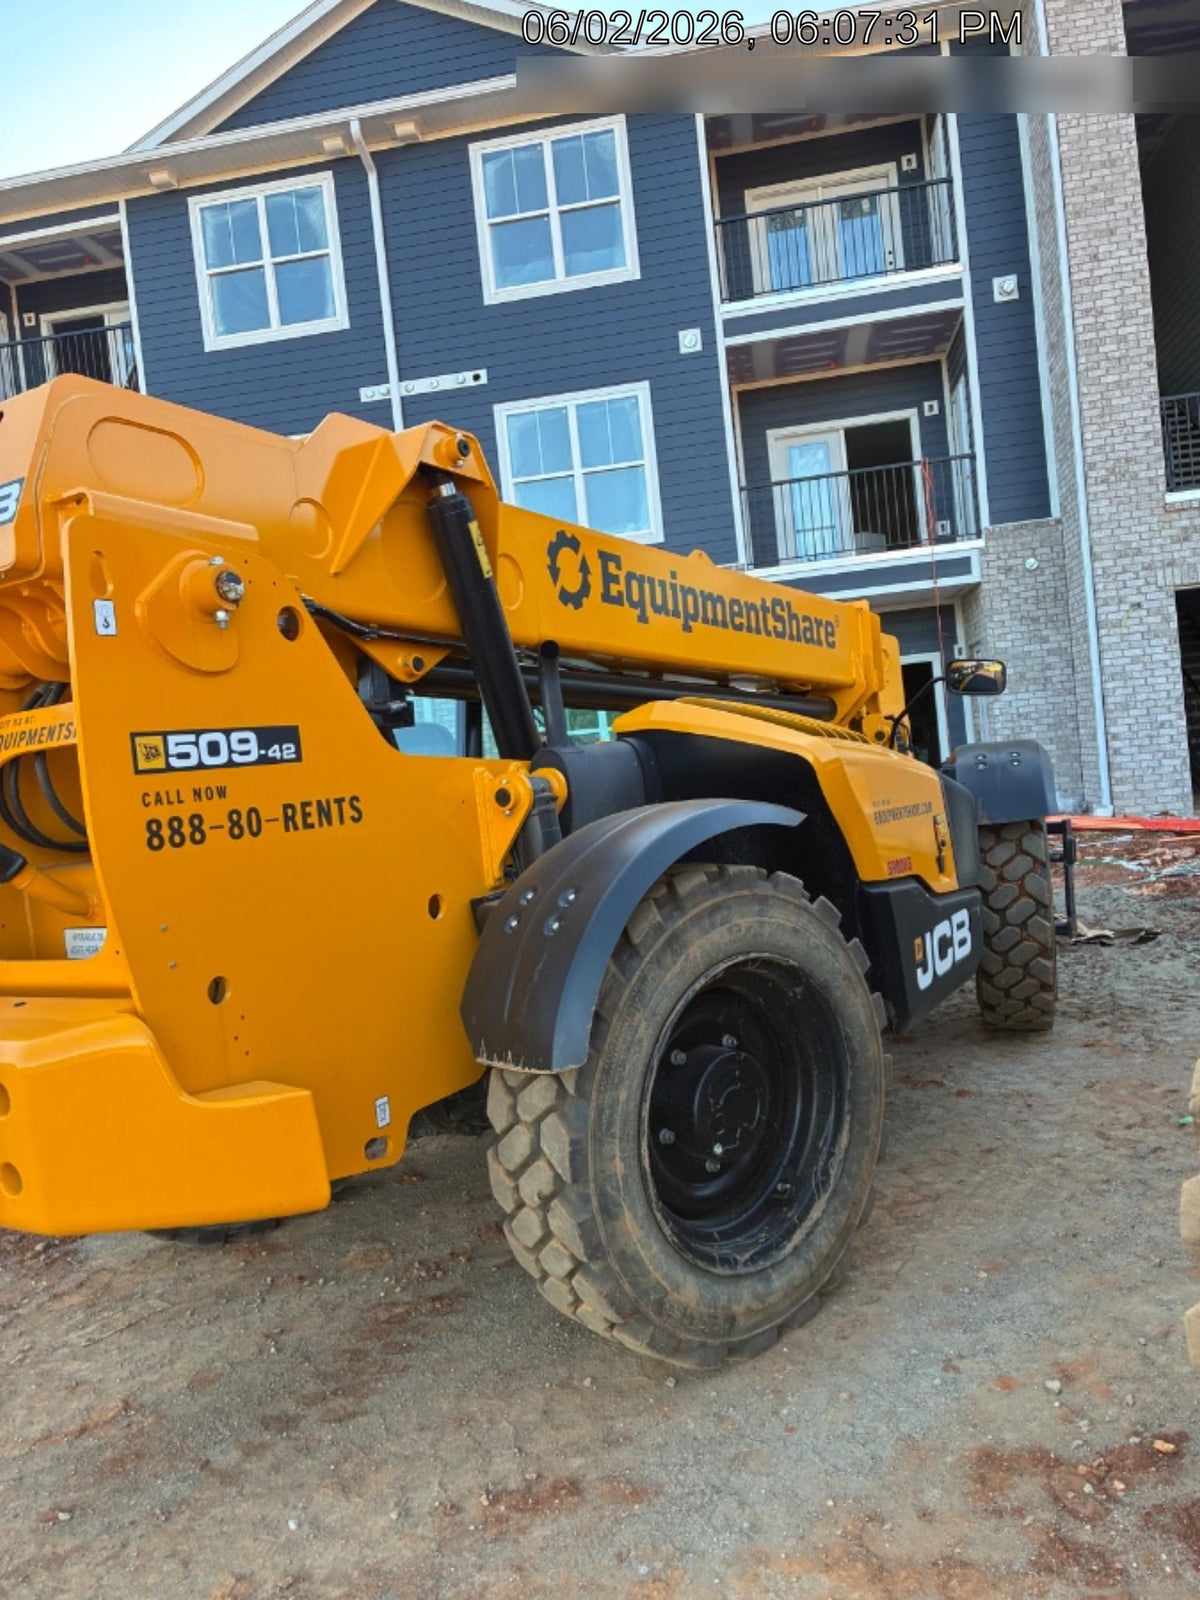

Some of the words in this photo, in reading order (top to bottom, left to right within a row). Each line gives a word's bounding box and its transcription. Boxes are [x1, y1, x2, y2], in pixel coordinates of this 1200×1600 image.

[597, 549, 837, 650] EquipmentShare
[166, 730, 297, 769] 509-42
[141, 790, 185, 808] CALL
[192, 785, 228, 803] NOW
[145, 795, 364, 852] 888-80-RENTS
[916, 907, 972, 991] JCB
